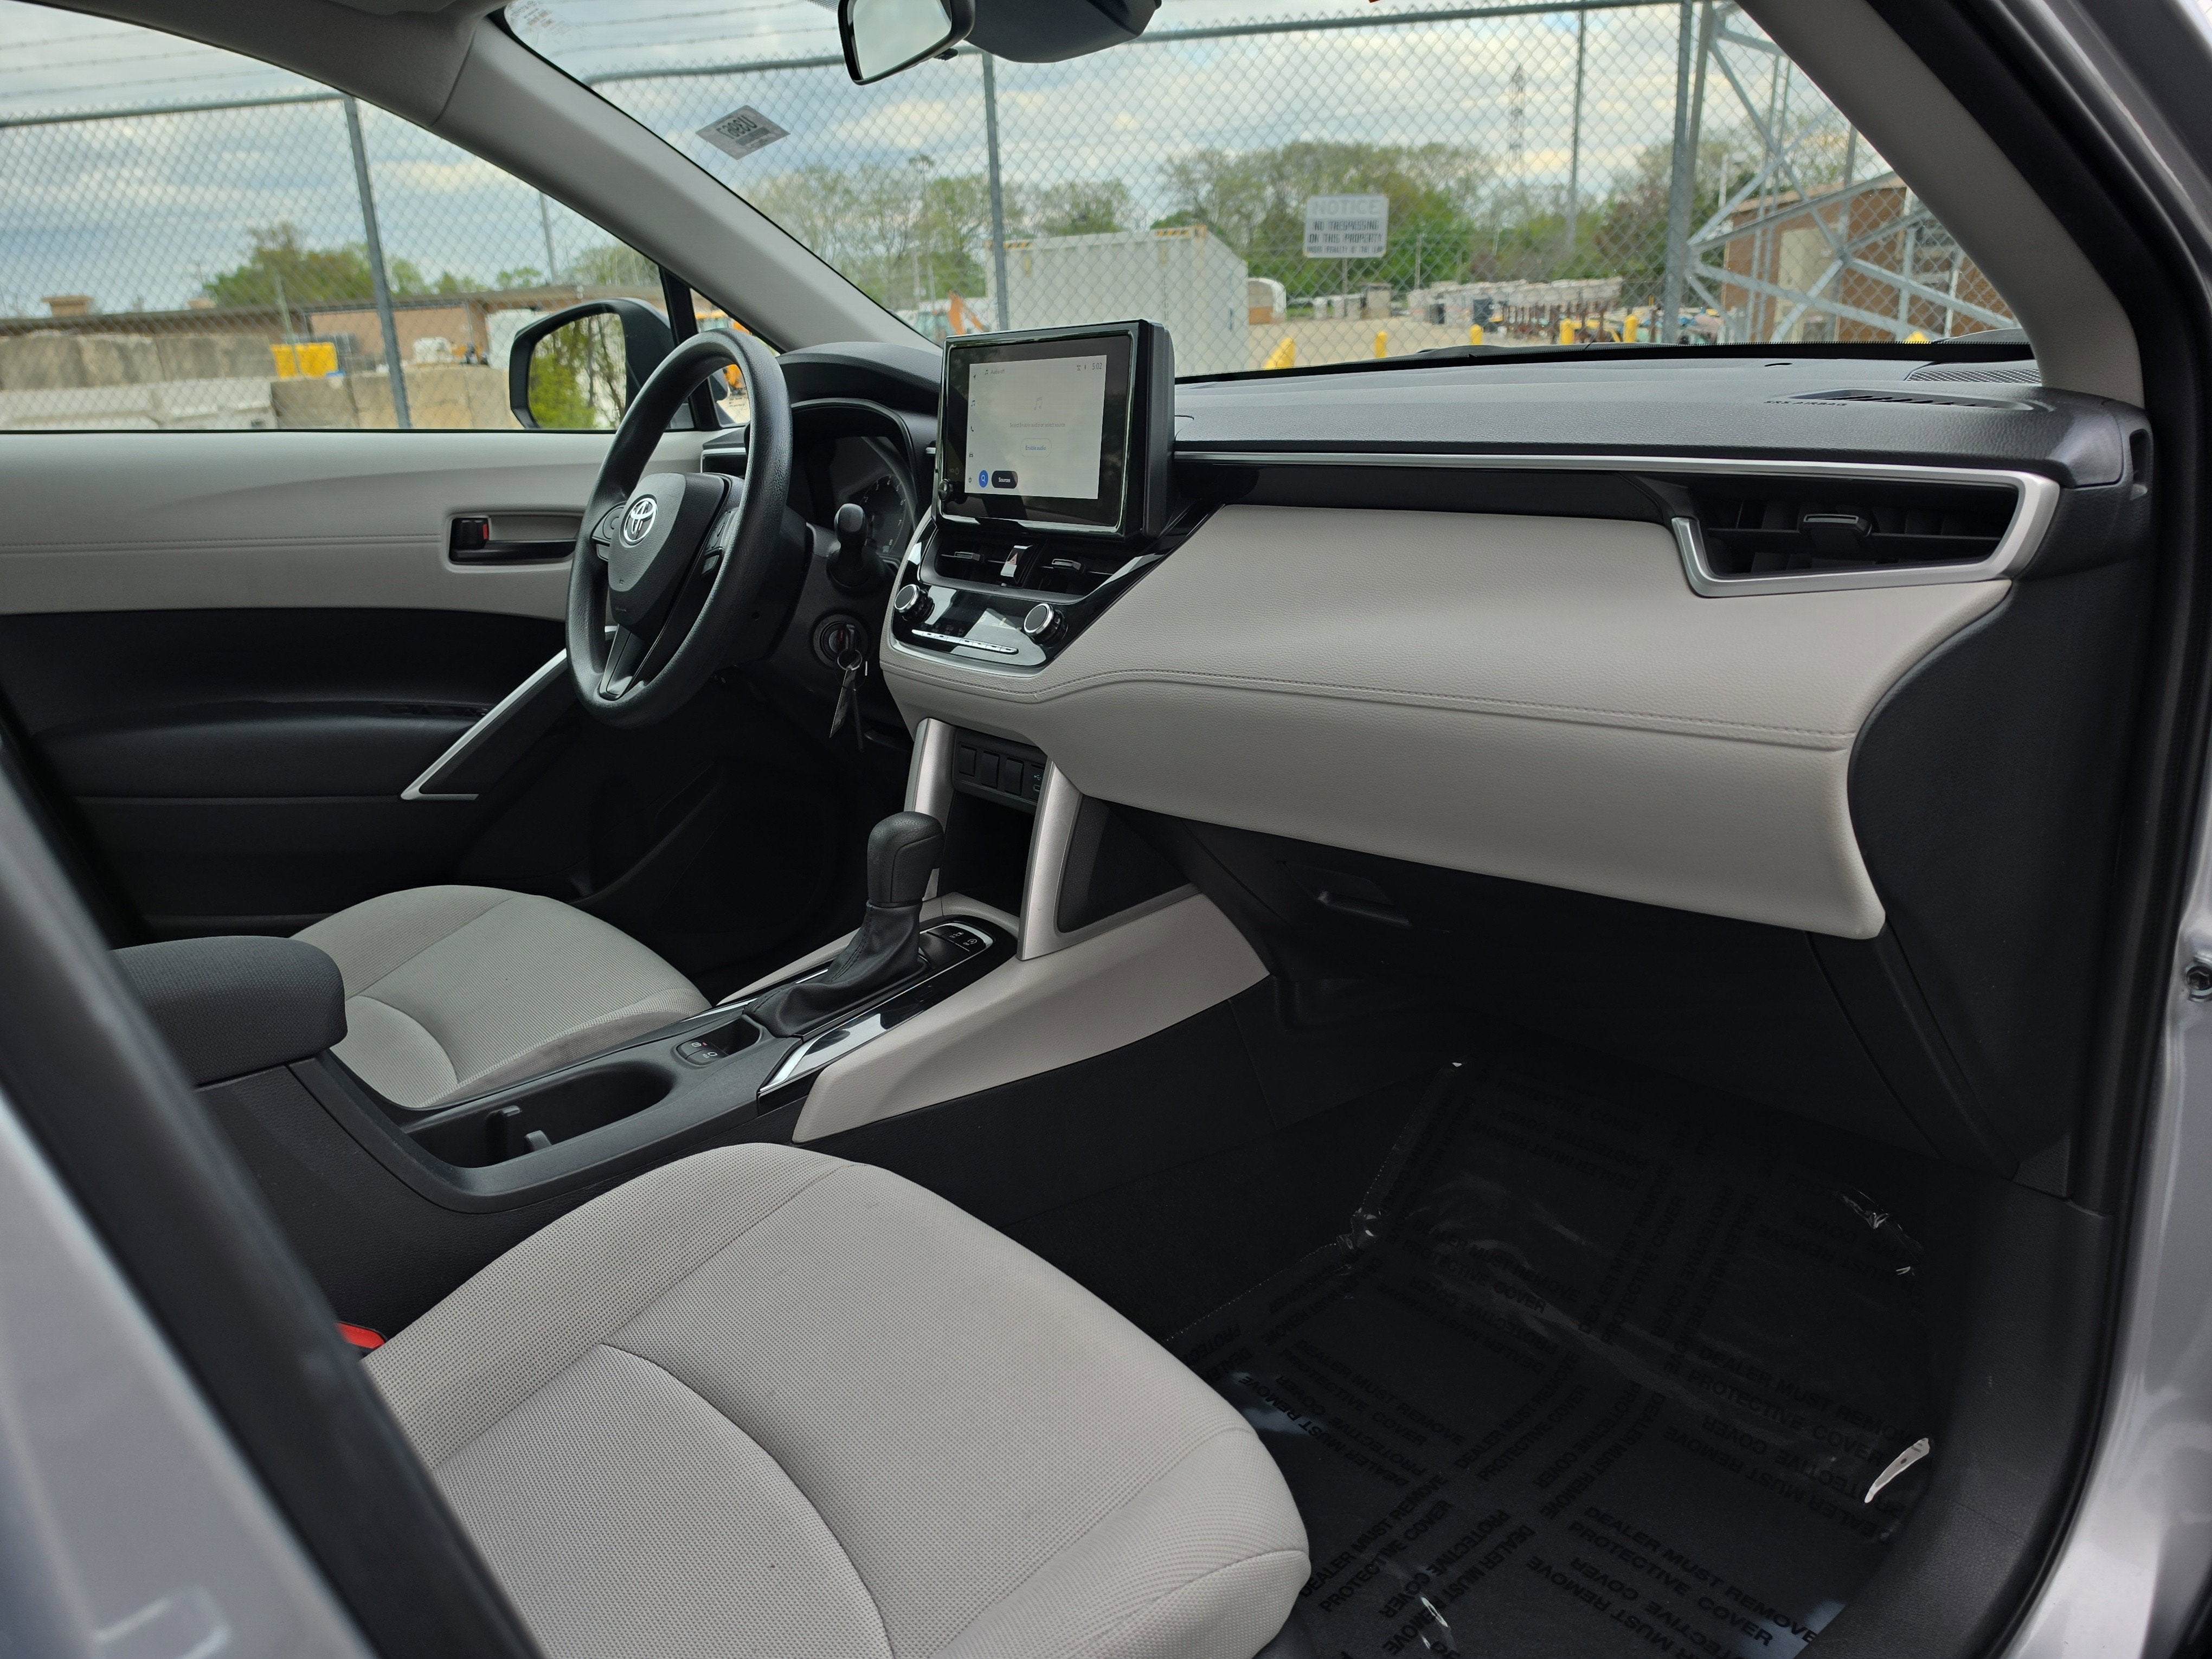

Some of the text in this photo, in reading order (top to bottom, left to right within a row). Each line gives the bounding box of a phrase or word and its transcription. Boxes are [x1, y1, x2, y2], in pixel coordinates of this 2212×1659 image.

[1313, 200, 1381, 215] NOTICE
[1314, 220, 1379, 231] NO TRESPASSING
[1309, 233, 1382, 243] ON THIS PROPERTY
[1092, 362, 1102, 370] 5:02
[1584, 1506, 1662, 1553] DEALER
[1662, 1547, 1726, 1589] MUST
[1567, 1520, 1773, 1647] PROTECTIVE COVER
